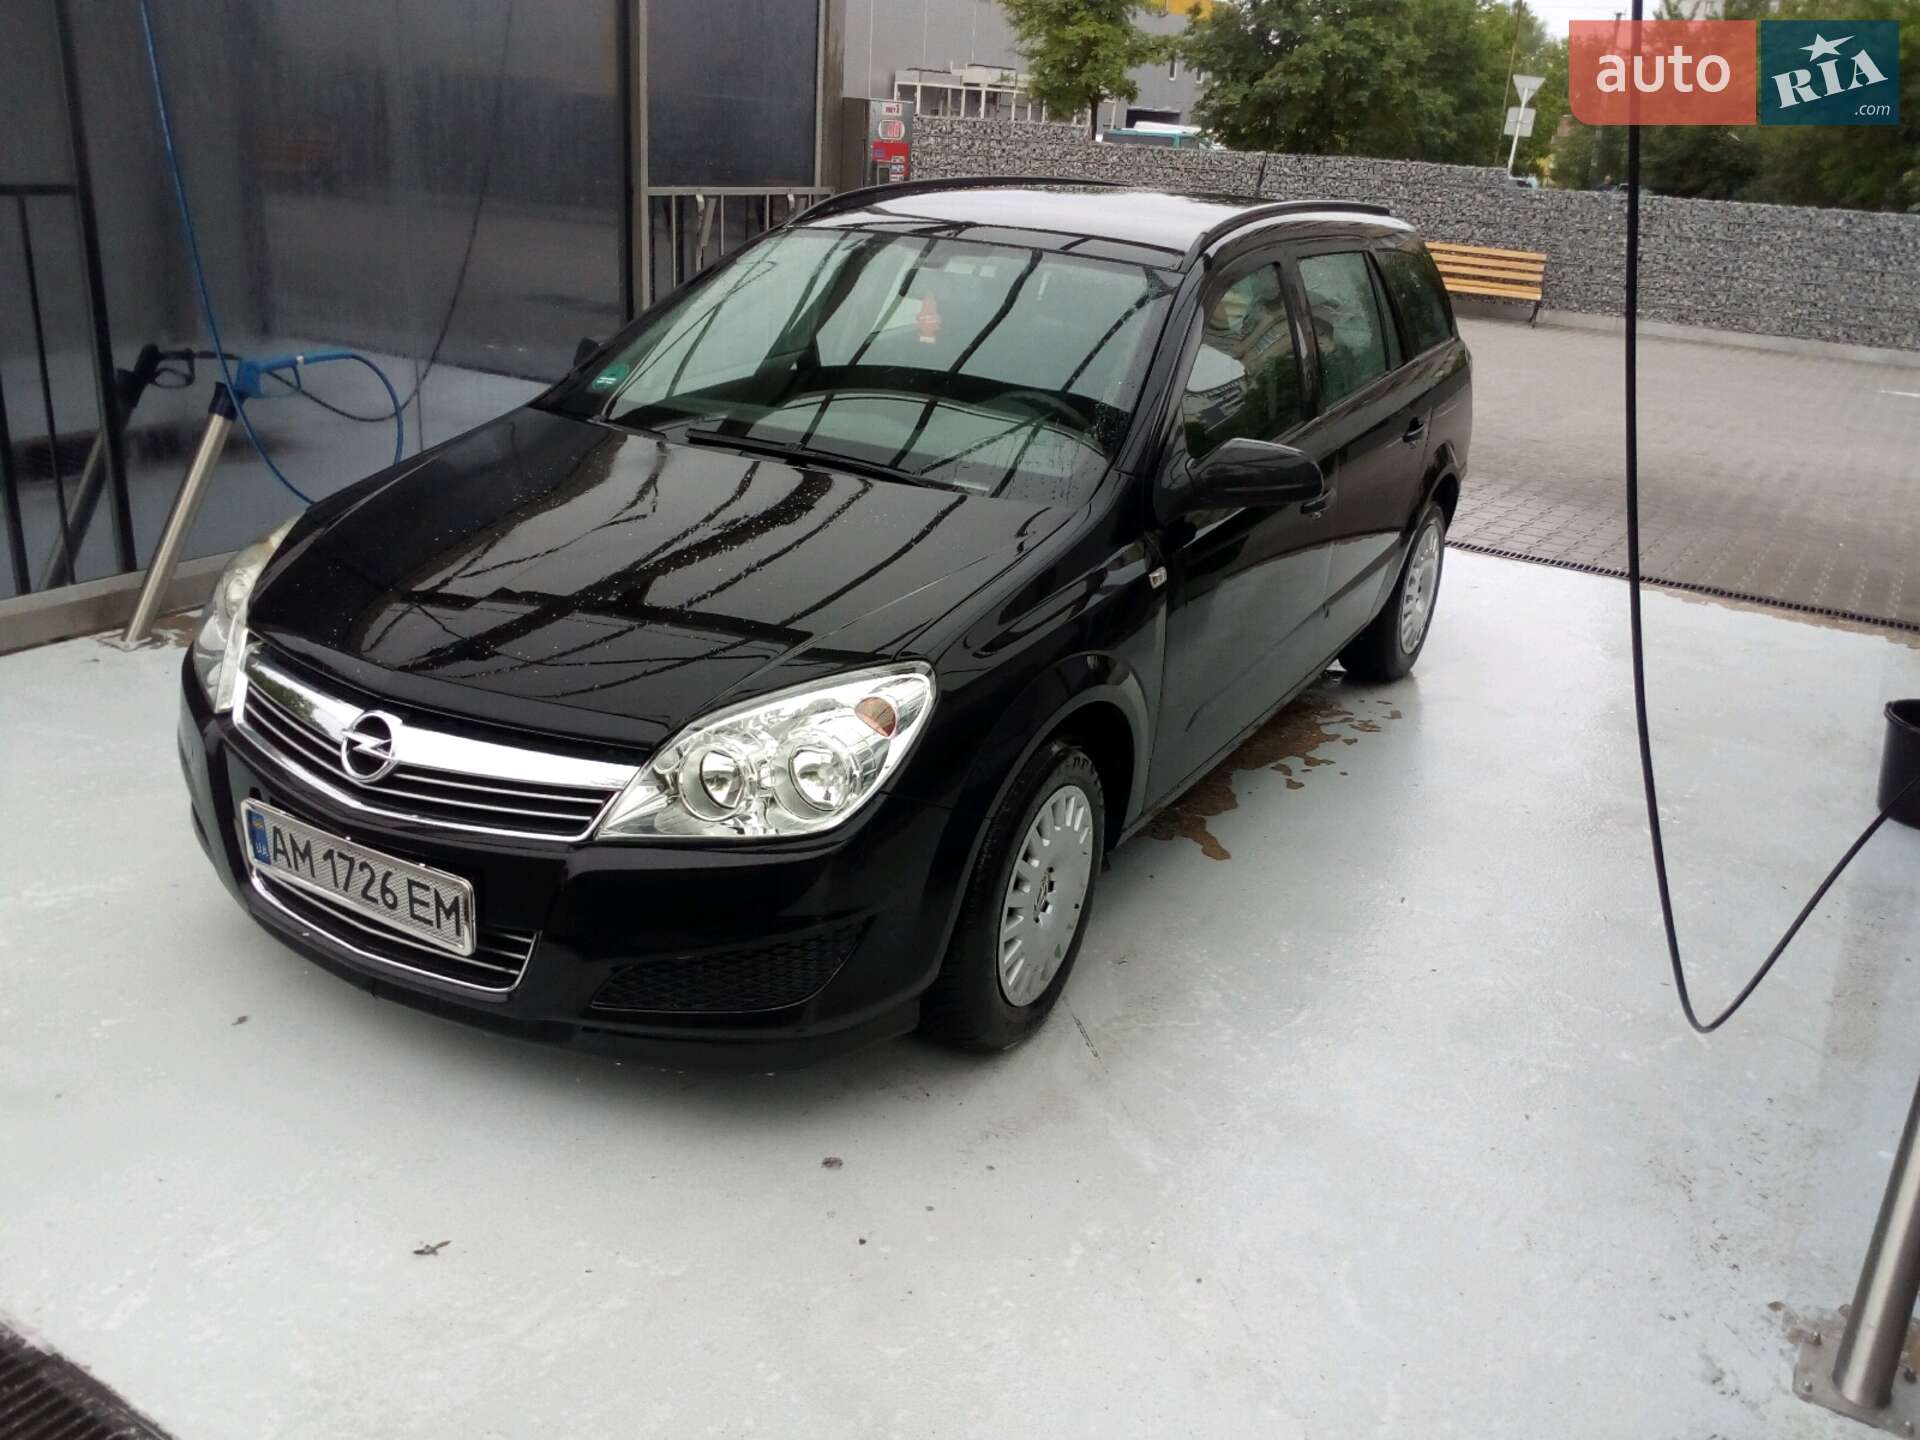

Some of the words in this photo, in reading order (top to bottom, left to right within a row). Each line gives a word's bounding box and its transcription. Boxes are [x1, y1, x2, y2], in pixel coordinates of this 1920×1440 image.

[272, 825, 316, 879] AM
[322, 848, 398, 910] 1726
[407, 877, 463, 937] EM
